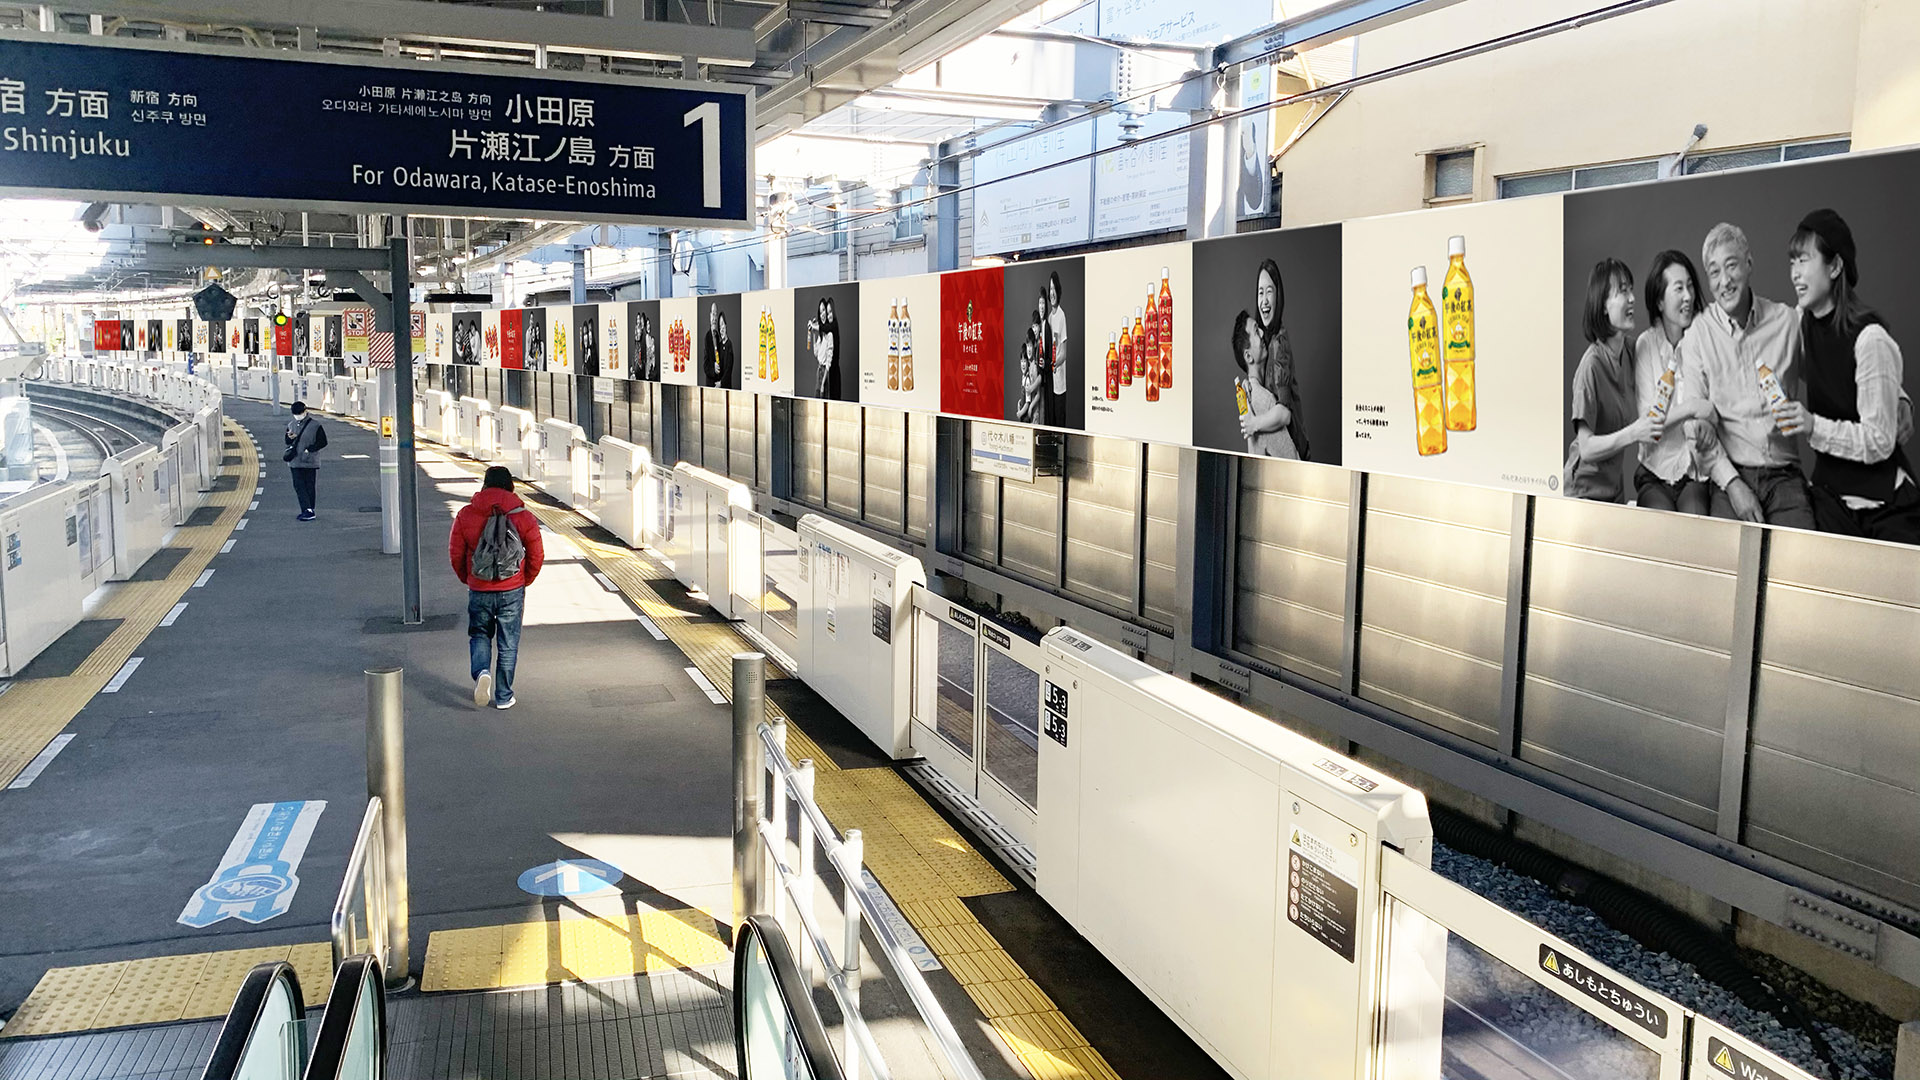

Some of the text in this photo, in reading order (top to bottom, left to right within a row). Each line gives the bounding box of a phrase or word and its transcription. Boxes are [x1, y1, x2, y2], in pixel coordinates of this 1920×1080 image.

[45, 88, 109, 119] 方面
[130, 90, 197, 107] 新宿 方向
[322, 99, 492, 121] 오다와라 가타세에노시마 방면
[359, 85, 396, 99] 小田原
[467, 93, 492, 106] 方向
[505, 94, 595, 127] 小田原
[131, 109, 206, 126] 신주쿠 방면
[3, 127, 130, 160] Shinjuku
[448, 129, 655, 170] 片瀬江ノ島 方面
[683, 102, 721, 208] 1
[353, 165, 656, 198] For Odawara, Katase-Enoshima
[1562, 962, 1661, 1026] あしもとちゅうい
